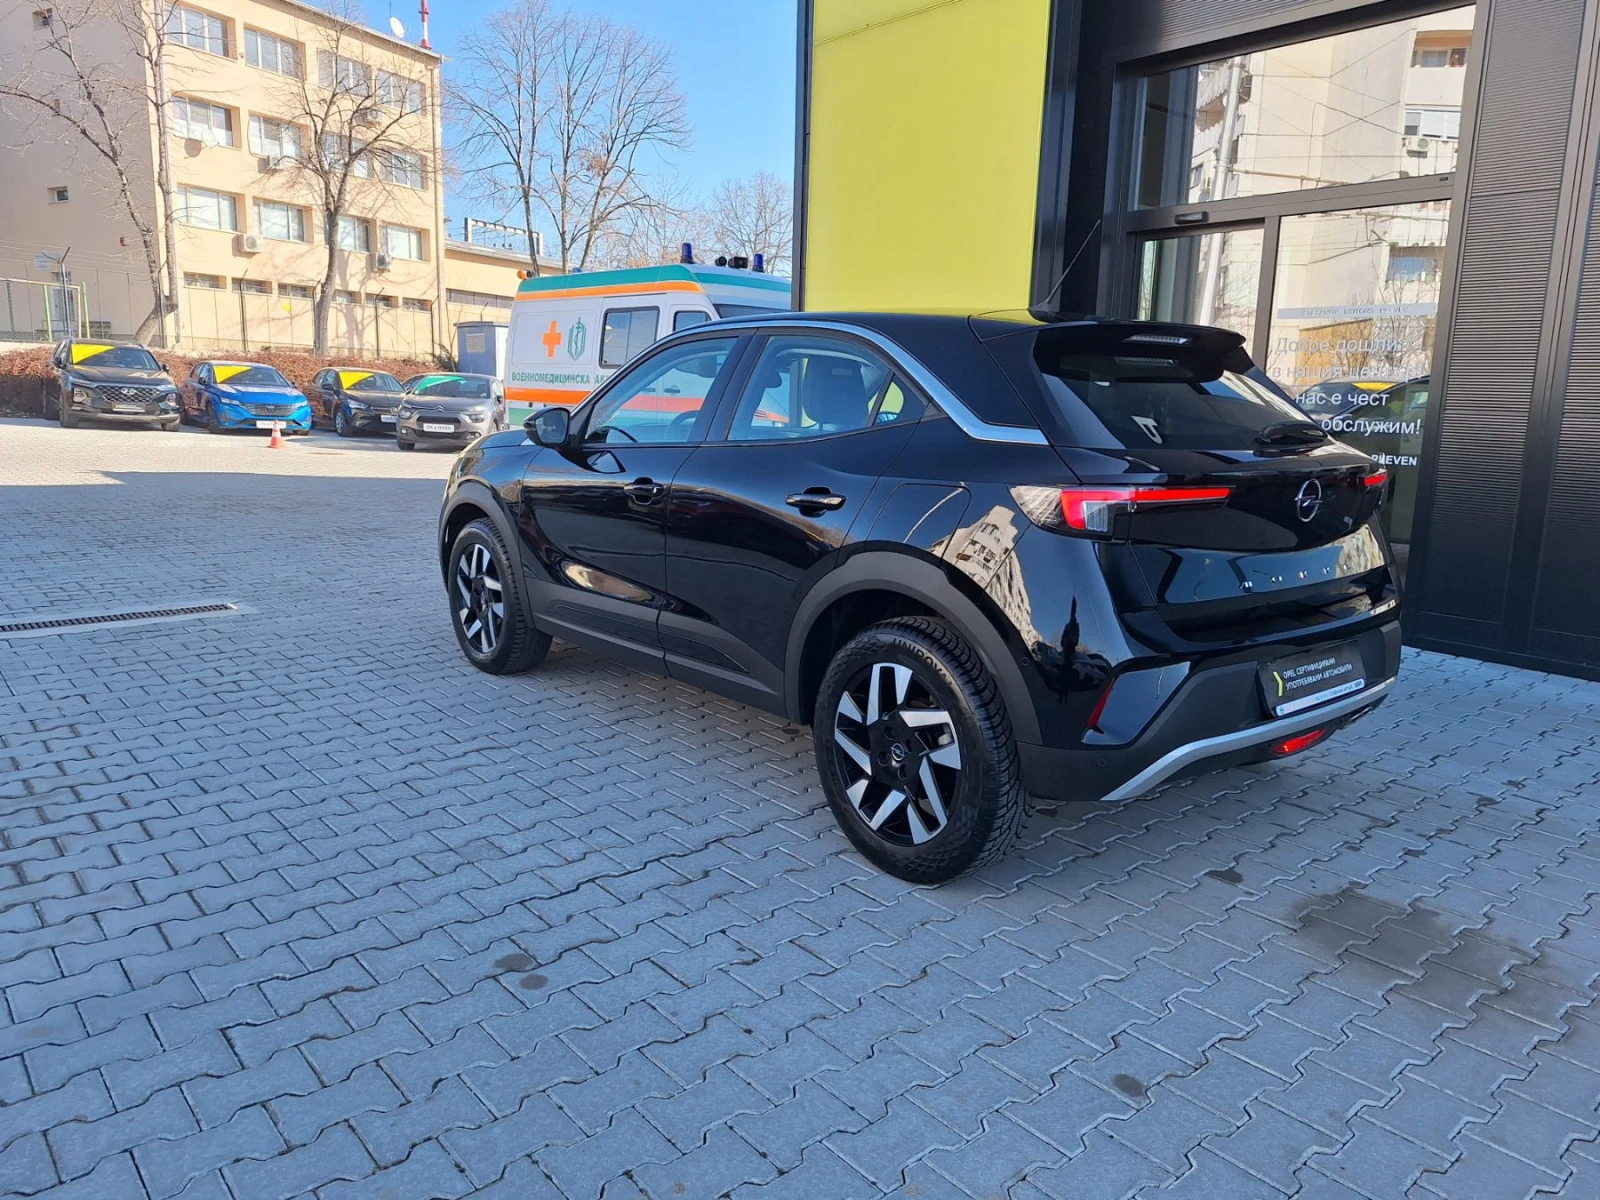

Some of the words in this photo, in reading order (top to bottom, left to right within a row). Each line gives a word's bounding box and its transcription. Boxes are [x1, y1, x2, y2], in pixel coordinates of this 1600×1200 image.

[1274, 337, 1331, 355] Добре
[511, 372, 591, 385] ВОЕННОМЕДИЦИНСКА
[1272, 368, 1281, 377] в
[1286, 367, 1343, 378] нашия
[1331, 392, 1342, 405] е
[1347, 392, 1389, 405] чест
[1322, 415, 1421, 437] обслужим!
[1283, 668, 1297, 679] OPEL
